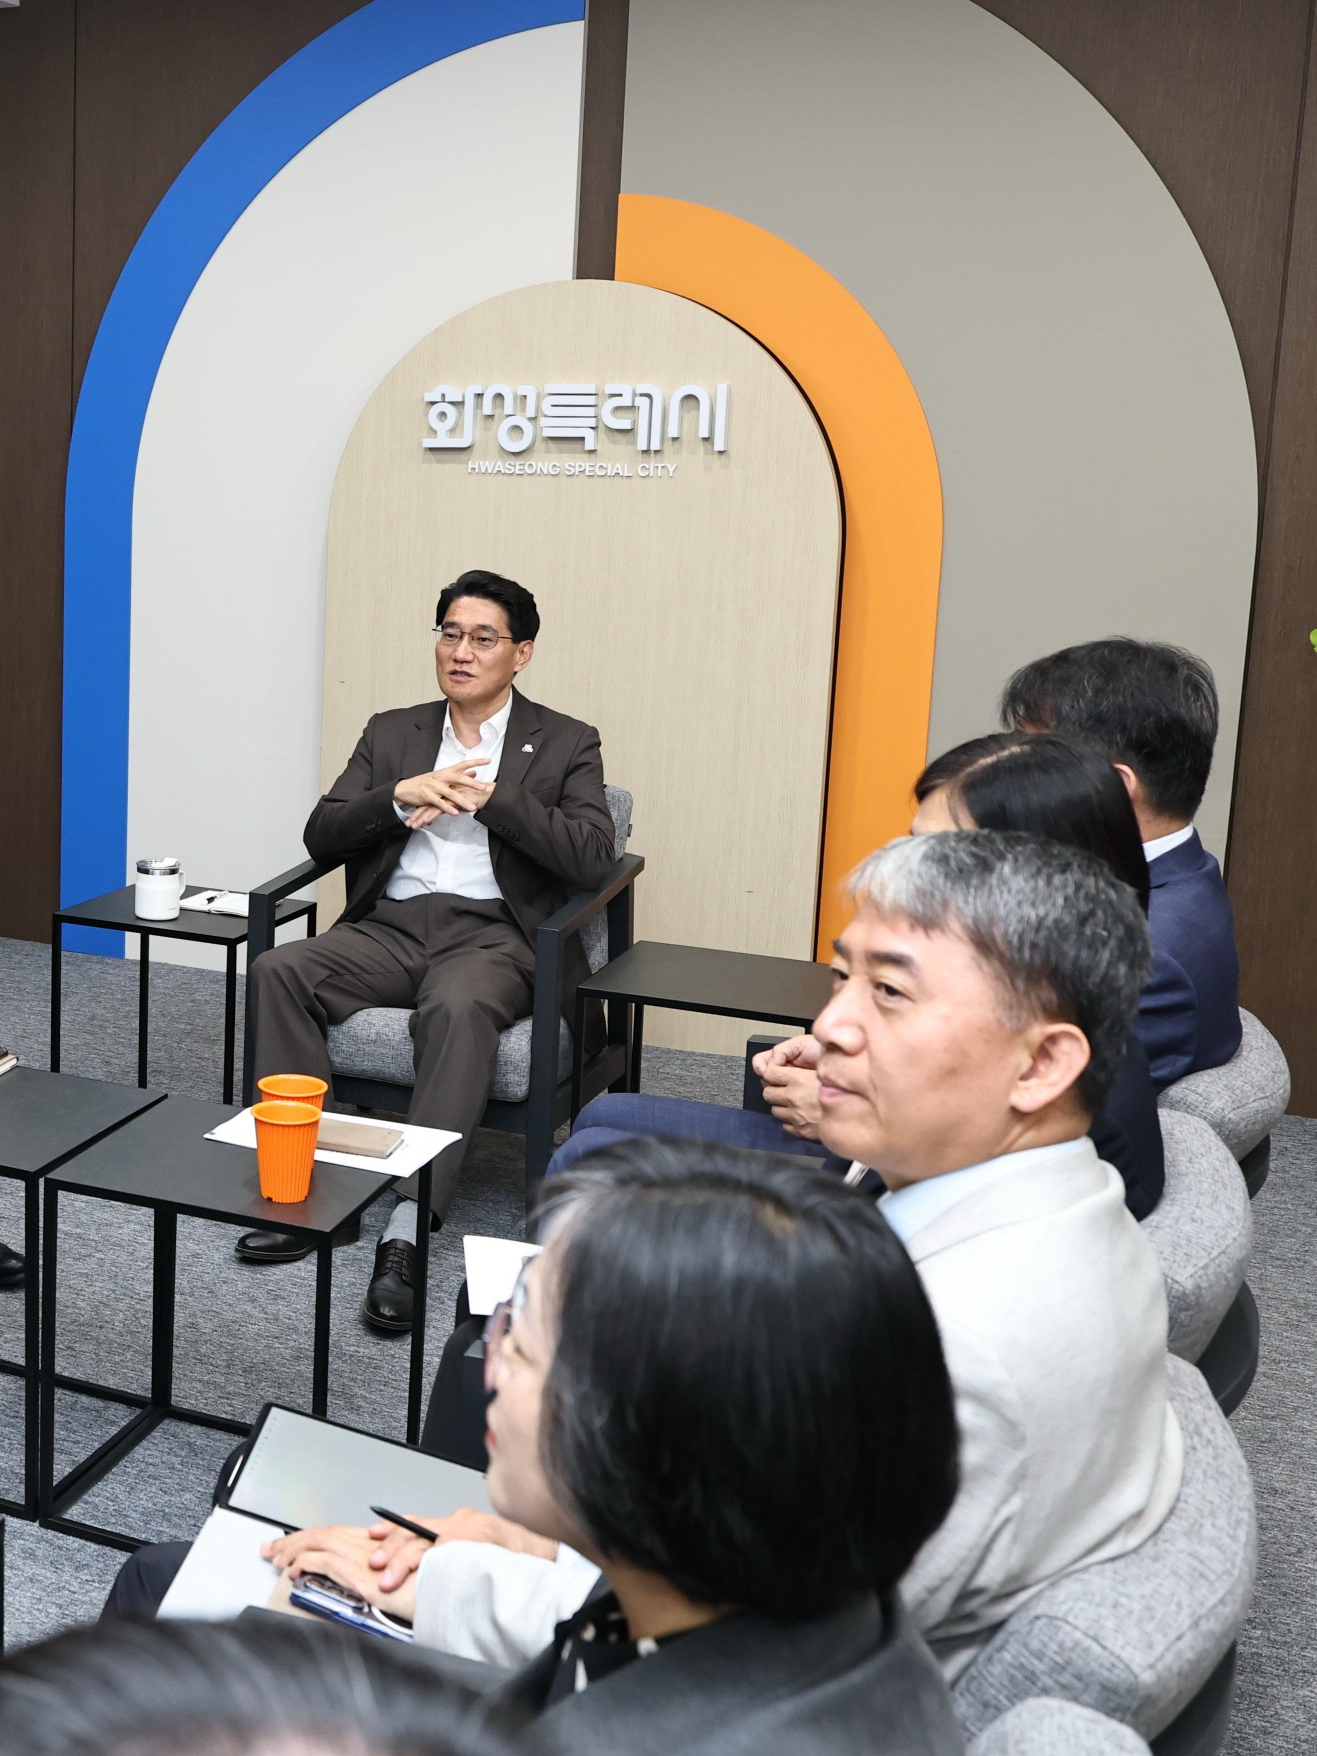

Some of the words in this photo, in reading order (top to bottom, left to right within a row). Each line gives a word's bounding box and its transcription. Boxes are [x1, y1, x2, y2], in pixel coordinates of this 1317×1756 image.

[421, 383, 731, 453] 화성특례시
[467, 460, 561, 476] HWASEONG
[564, 462, 633, 477] SPECIAL
[637, 463, 679, 477] CITY
